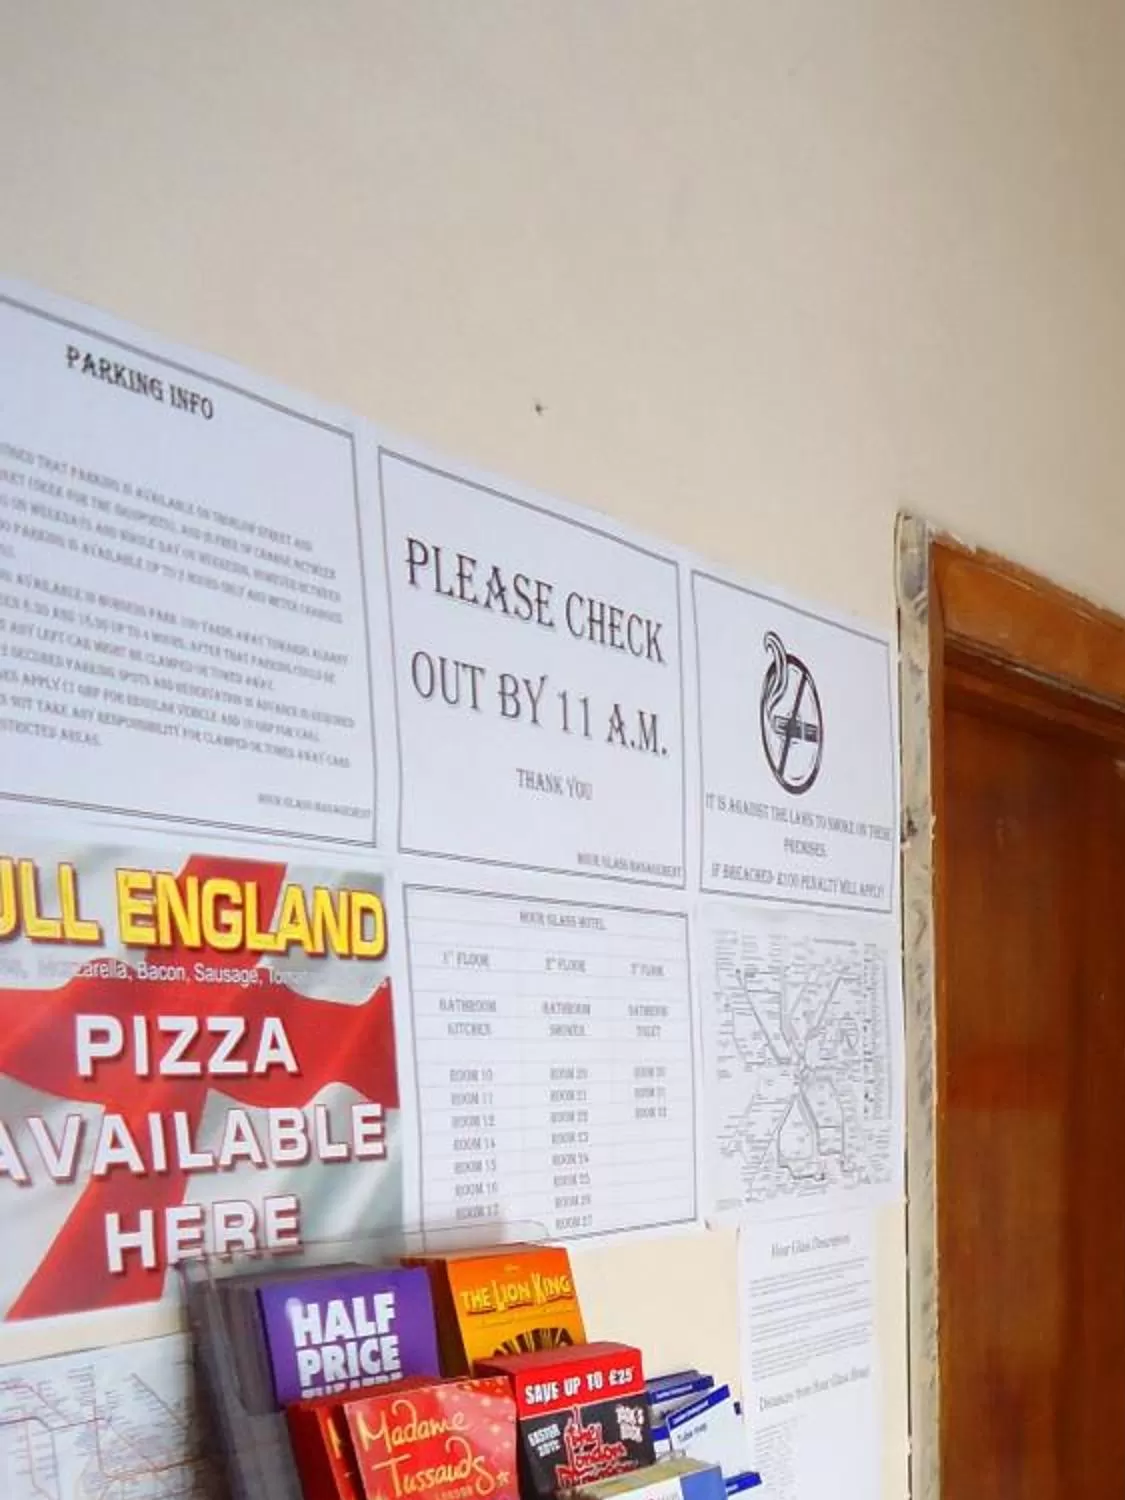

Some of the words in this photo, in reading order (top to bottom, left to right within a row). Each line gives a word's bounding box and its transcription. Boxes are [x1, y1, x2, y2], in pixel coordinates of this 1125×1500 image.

[66, 345, 164, 402] PARKING
[169, 384, 215, 420] INFO
[405, 537, 556, 628] PLEASE
[565, 591, 668, 666] CHECK
[411, 650, 486, 712] OUT
[498, 672, 549, 727] BY
[557, 689, 593, 739] 11
[606, 703, 670, 757] A.M.
[515, 767, 564, 796] THANK
[565, 775, 595, 801] YOU
[705, 792, 716, 810] IT
[717, 794, 727, 812] IS
[728, 796, 769, 819] AGAINST
[770, 803, 788, 822] THE
[711, 861, 720, 877] IF
[116, 867, 389, 958] ENGLAND
[137, 961, 191, 983] Bacon,
[194, 963, 263, 986] Sausage,
[75, 1014, 300, 1077] PIZZA
[0, 1103, 386, 1186] AVAILABLE
[105, 1195, 300, 1274] HERE
[291, 1292, 396, 1347] HALF
[460, 1286, 491, 1314] THE
[531, 1271, 573, 1305] KING
[296, 1335, 401, 1388] PRICE
[524, 1381, 559, 1405] SAVE
[563, 1377, 581, 1395] UP
[586, 1372, 604, 1391] TO
[356, 1399, 470, 1453] Madame
[373, 1436, 495, 1497] Tussauds
